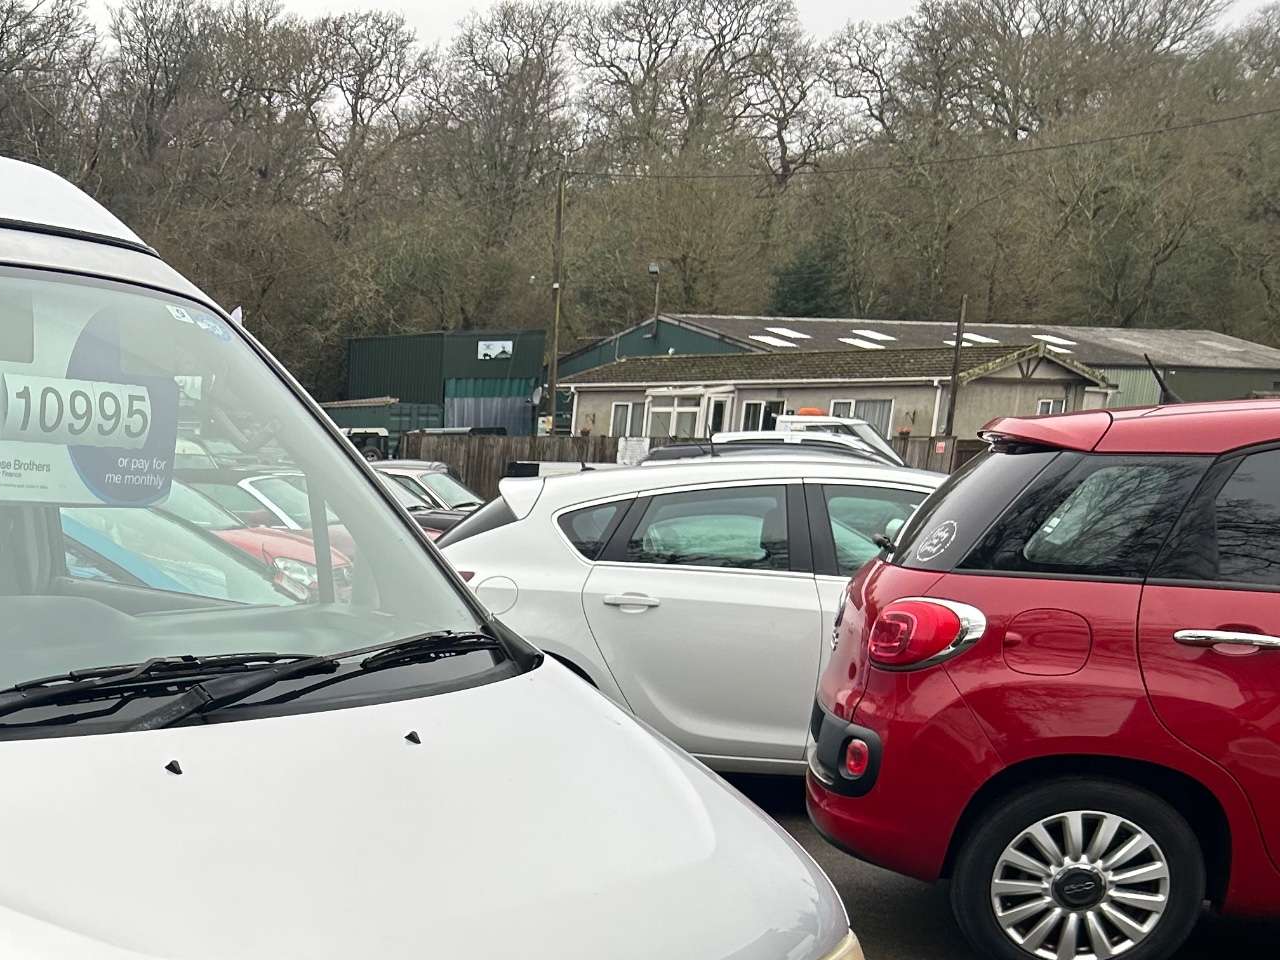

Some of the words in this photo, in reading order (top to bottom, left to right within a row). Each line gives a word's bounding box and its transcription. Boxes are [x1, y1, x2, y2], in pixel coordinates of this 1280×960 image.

[13, 459, 51, 473] Brothers
[117, 457, 129, 468] or
[131, 458, 150, 472] pay
[152, 457, 167, 470] for
[104, 473, 122, 484] me
[124, 473, 164, 490] monthly
